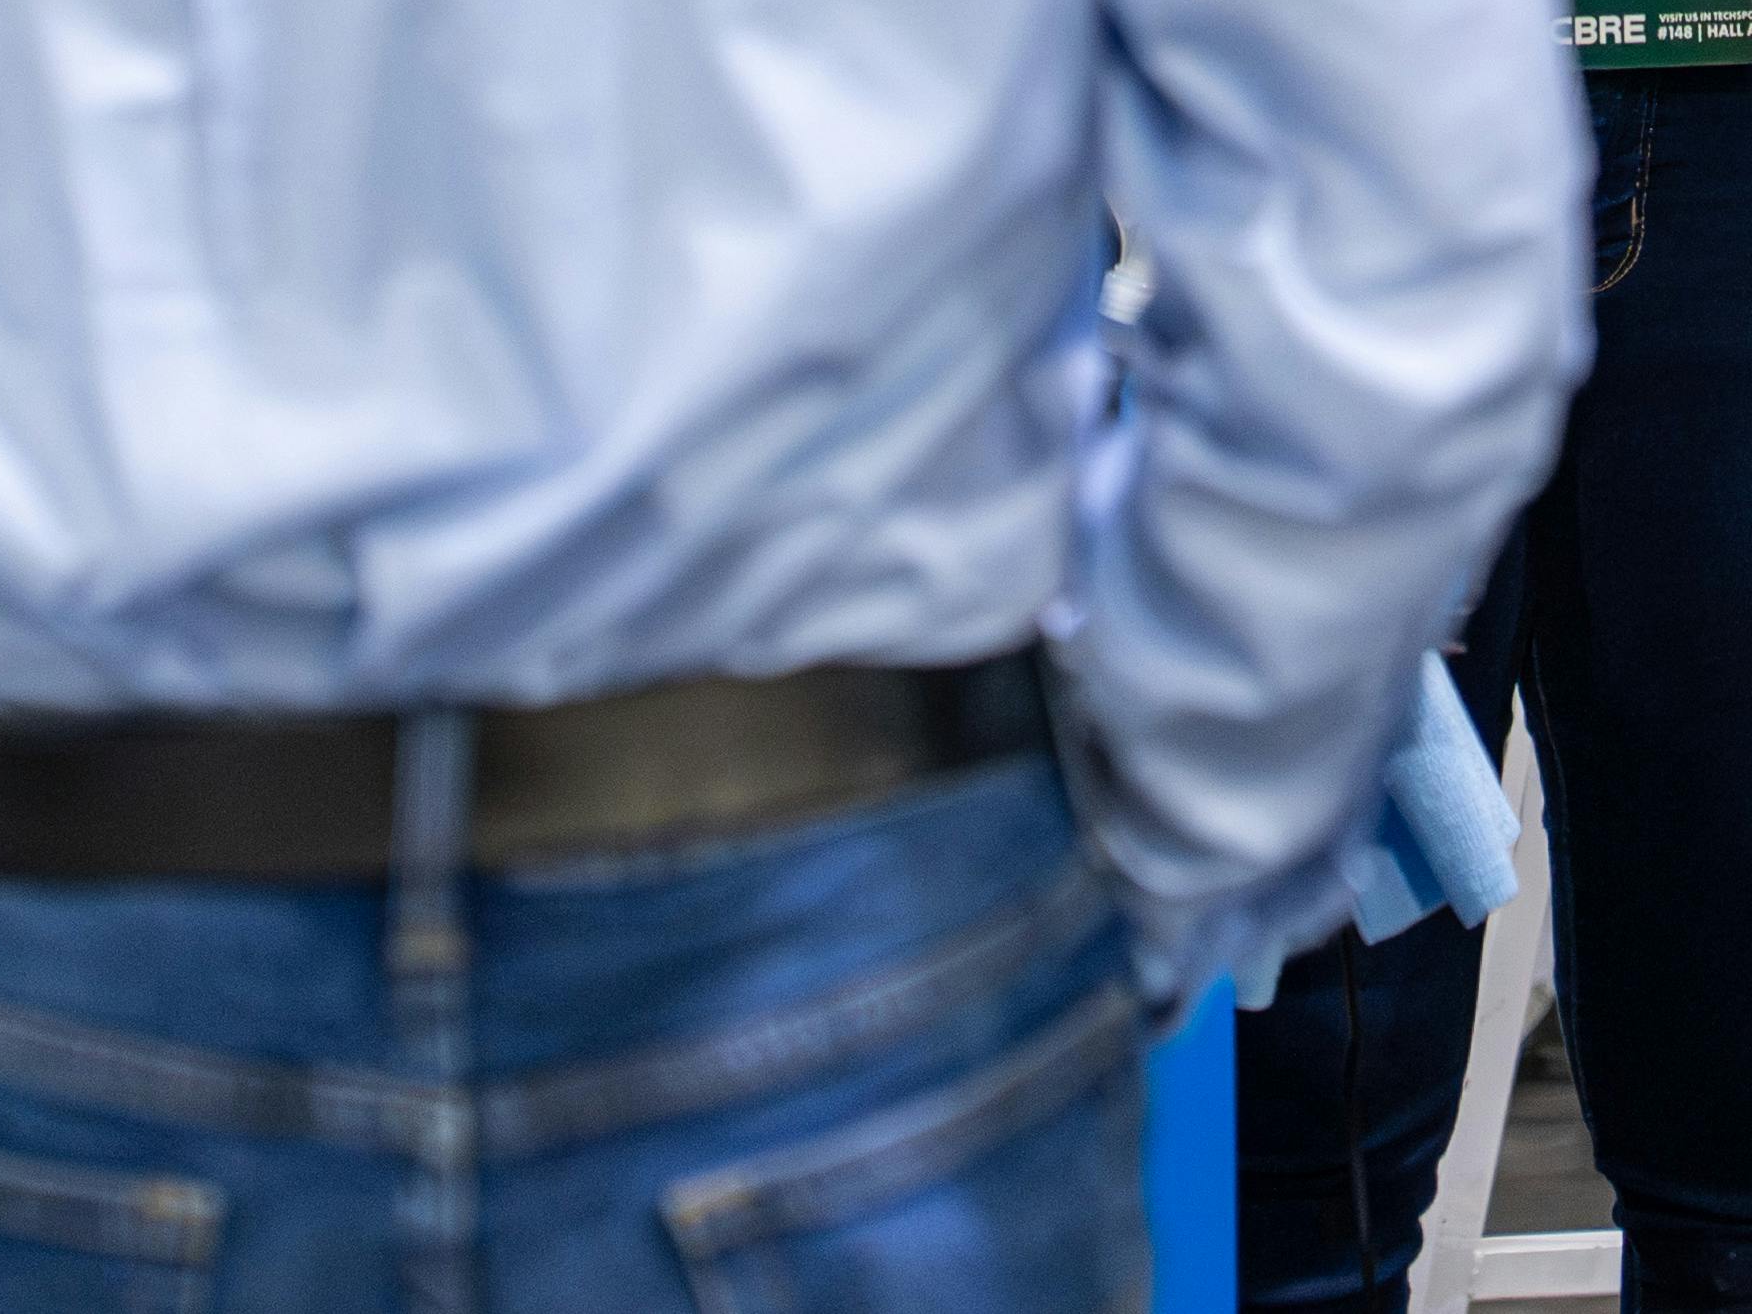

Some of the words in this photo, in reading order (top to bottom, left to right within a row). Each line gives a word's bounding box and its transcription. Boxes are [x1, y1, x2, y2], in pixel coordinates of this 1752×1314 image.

[1658, 12, 1683, 23] VISIT
[1684, 12, 1699, 22] US
[1700, 11, 1711, 22] IN
[1657, 24, 1693, 41] #148
[1707, 22, 1745, 39] HALL
